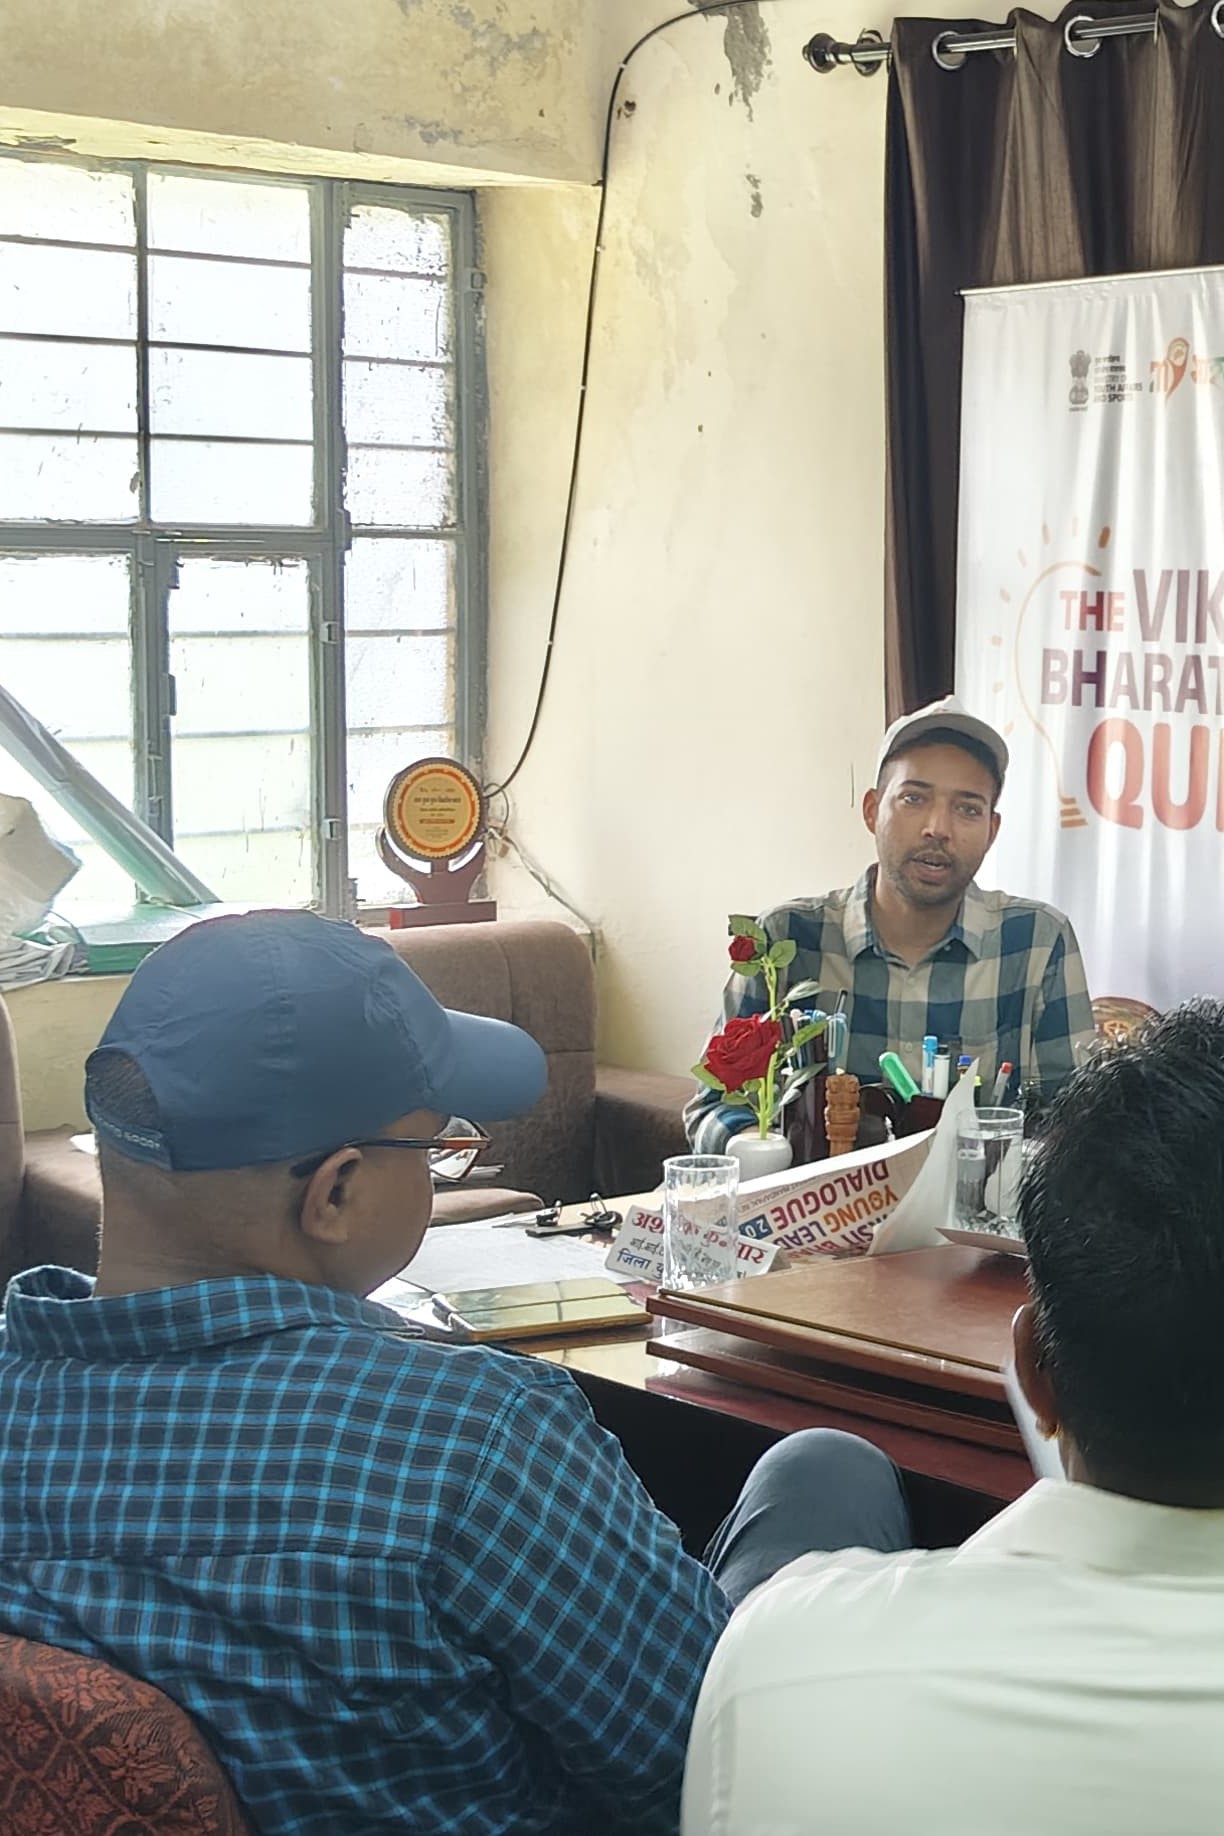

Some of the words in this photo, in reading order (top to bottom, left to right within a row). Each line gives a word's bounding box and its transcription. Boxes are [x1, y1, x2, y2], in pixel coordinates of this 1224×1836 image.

[1060, 590, 1126, 633] THE
[770, 1159, 889, 1230] DIALOGUE
[823, 1184, 899, 1233] YOUNG
[617, 1247, 652, 1270] जिला
